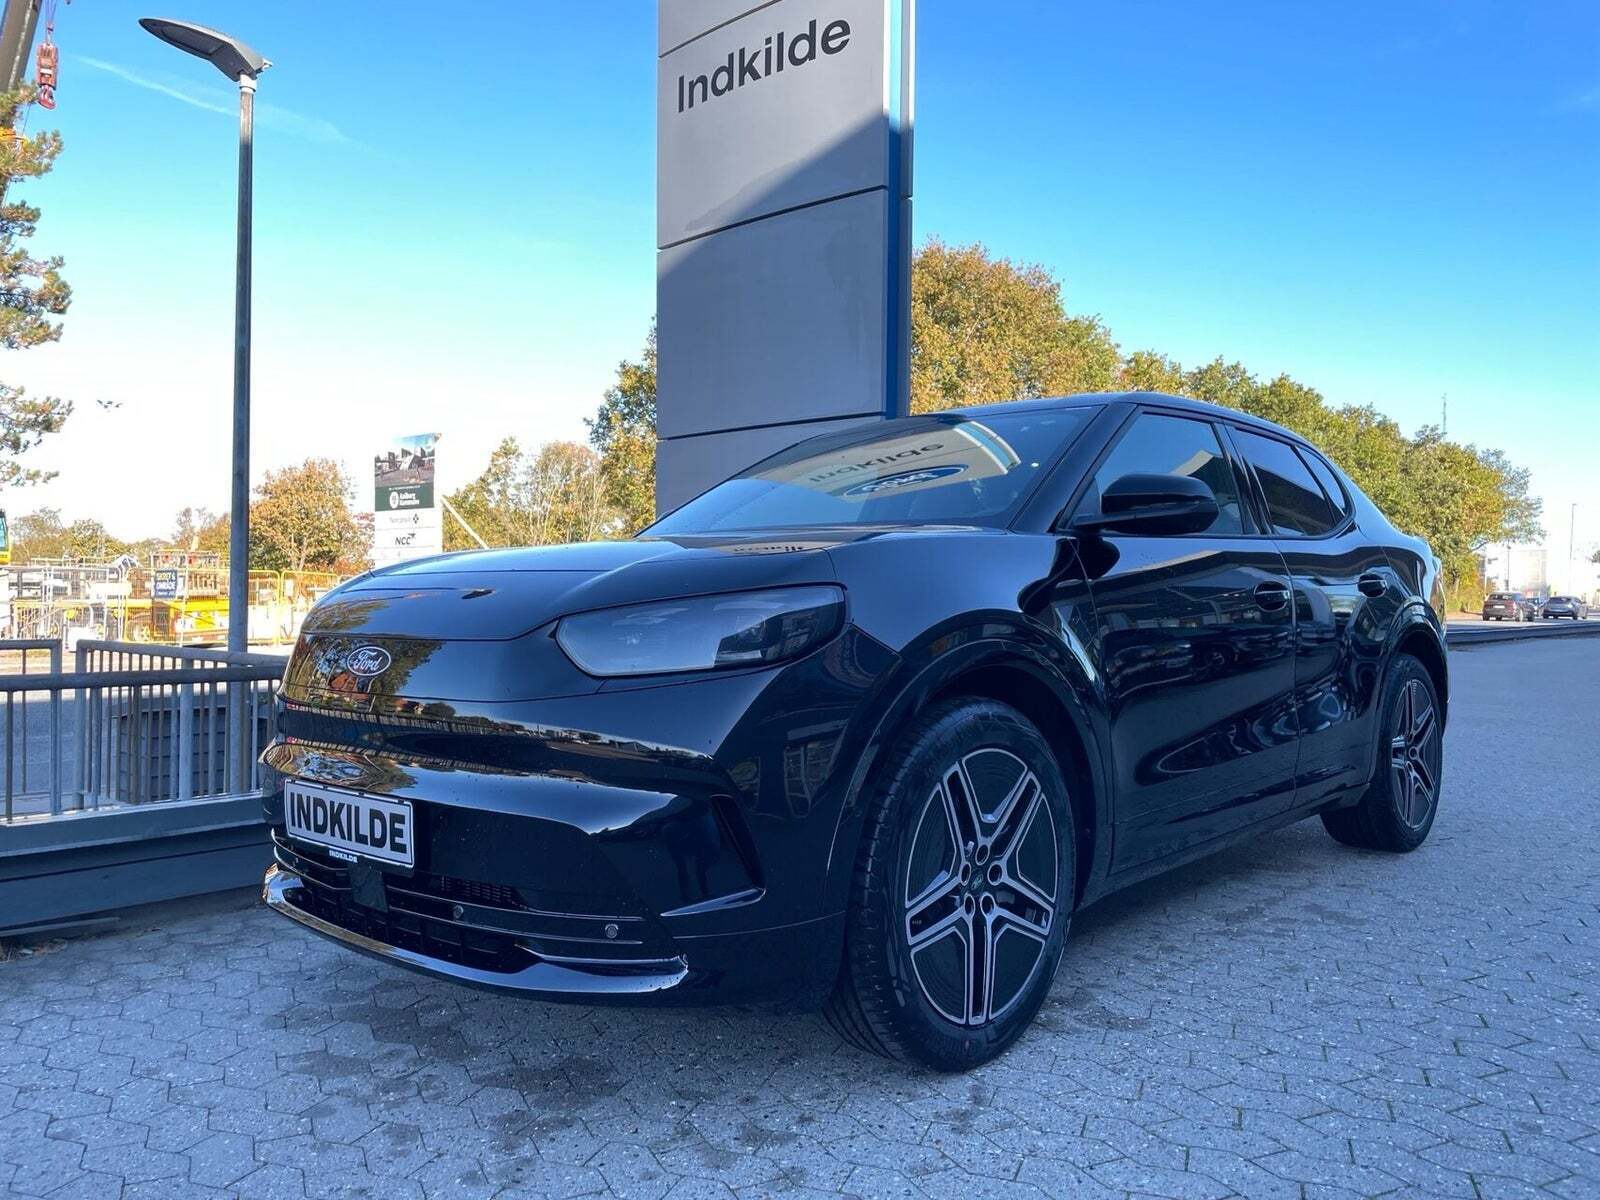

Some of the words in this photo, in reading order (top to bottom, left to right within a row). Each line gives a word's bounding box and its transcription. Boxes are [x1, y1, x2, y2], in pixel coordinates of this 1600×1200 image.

[678, 19, 850, 113] Indkilde
[394, 536, 411, 545] NCC
[350, 650, 382, 671] Ford
[290, 791, 408, 854] INDKILDE
